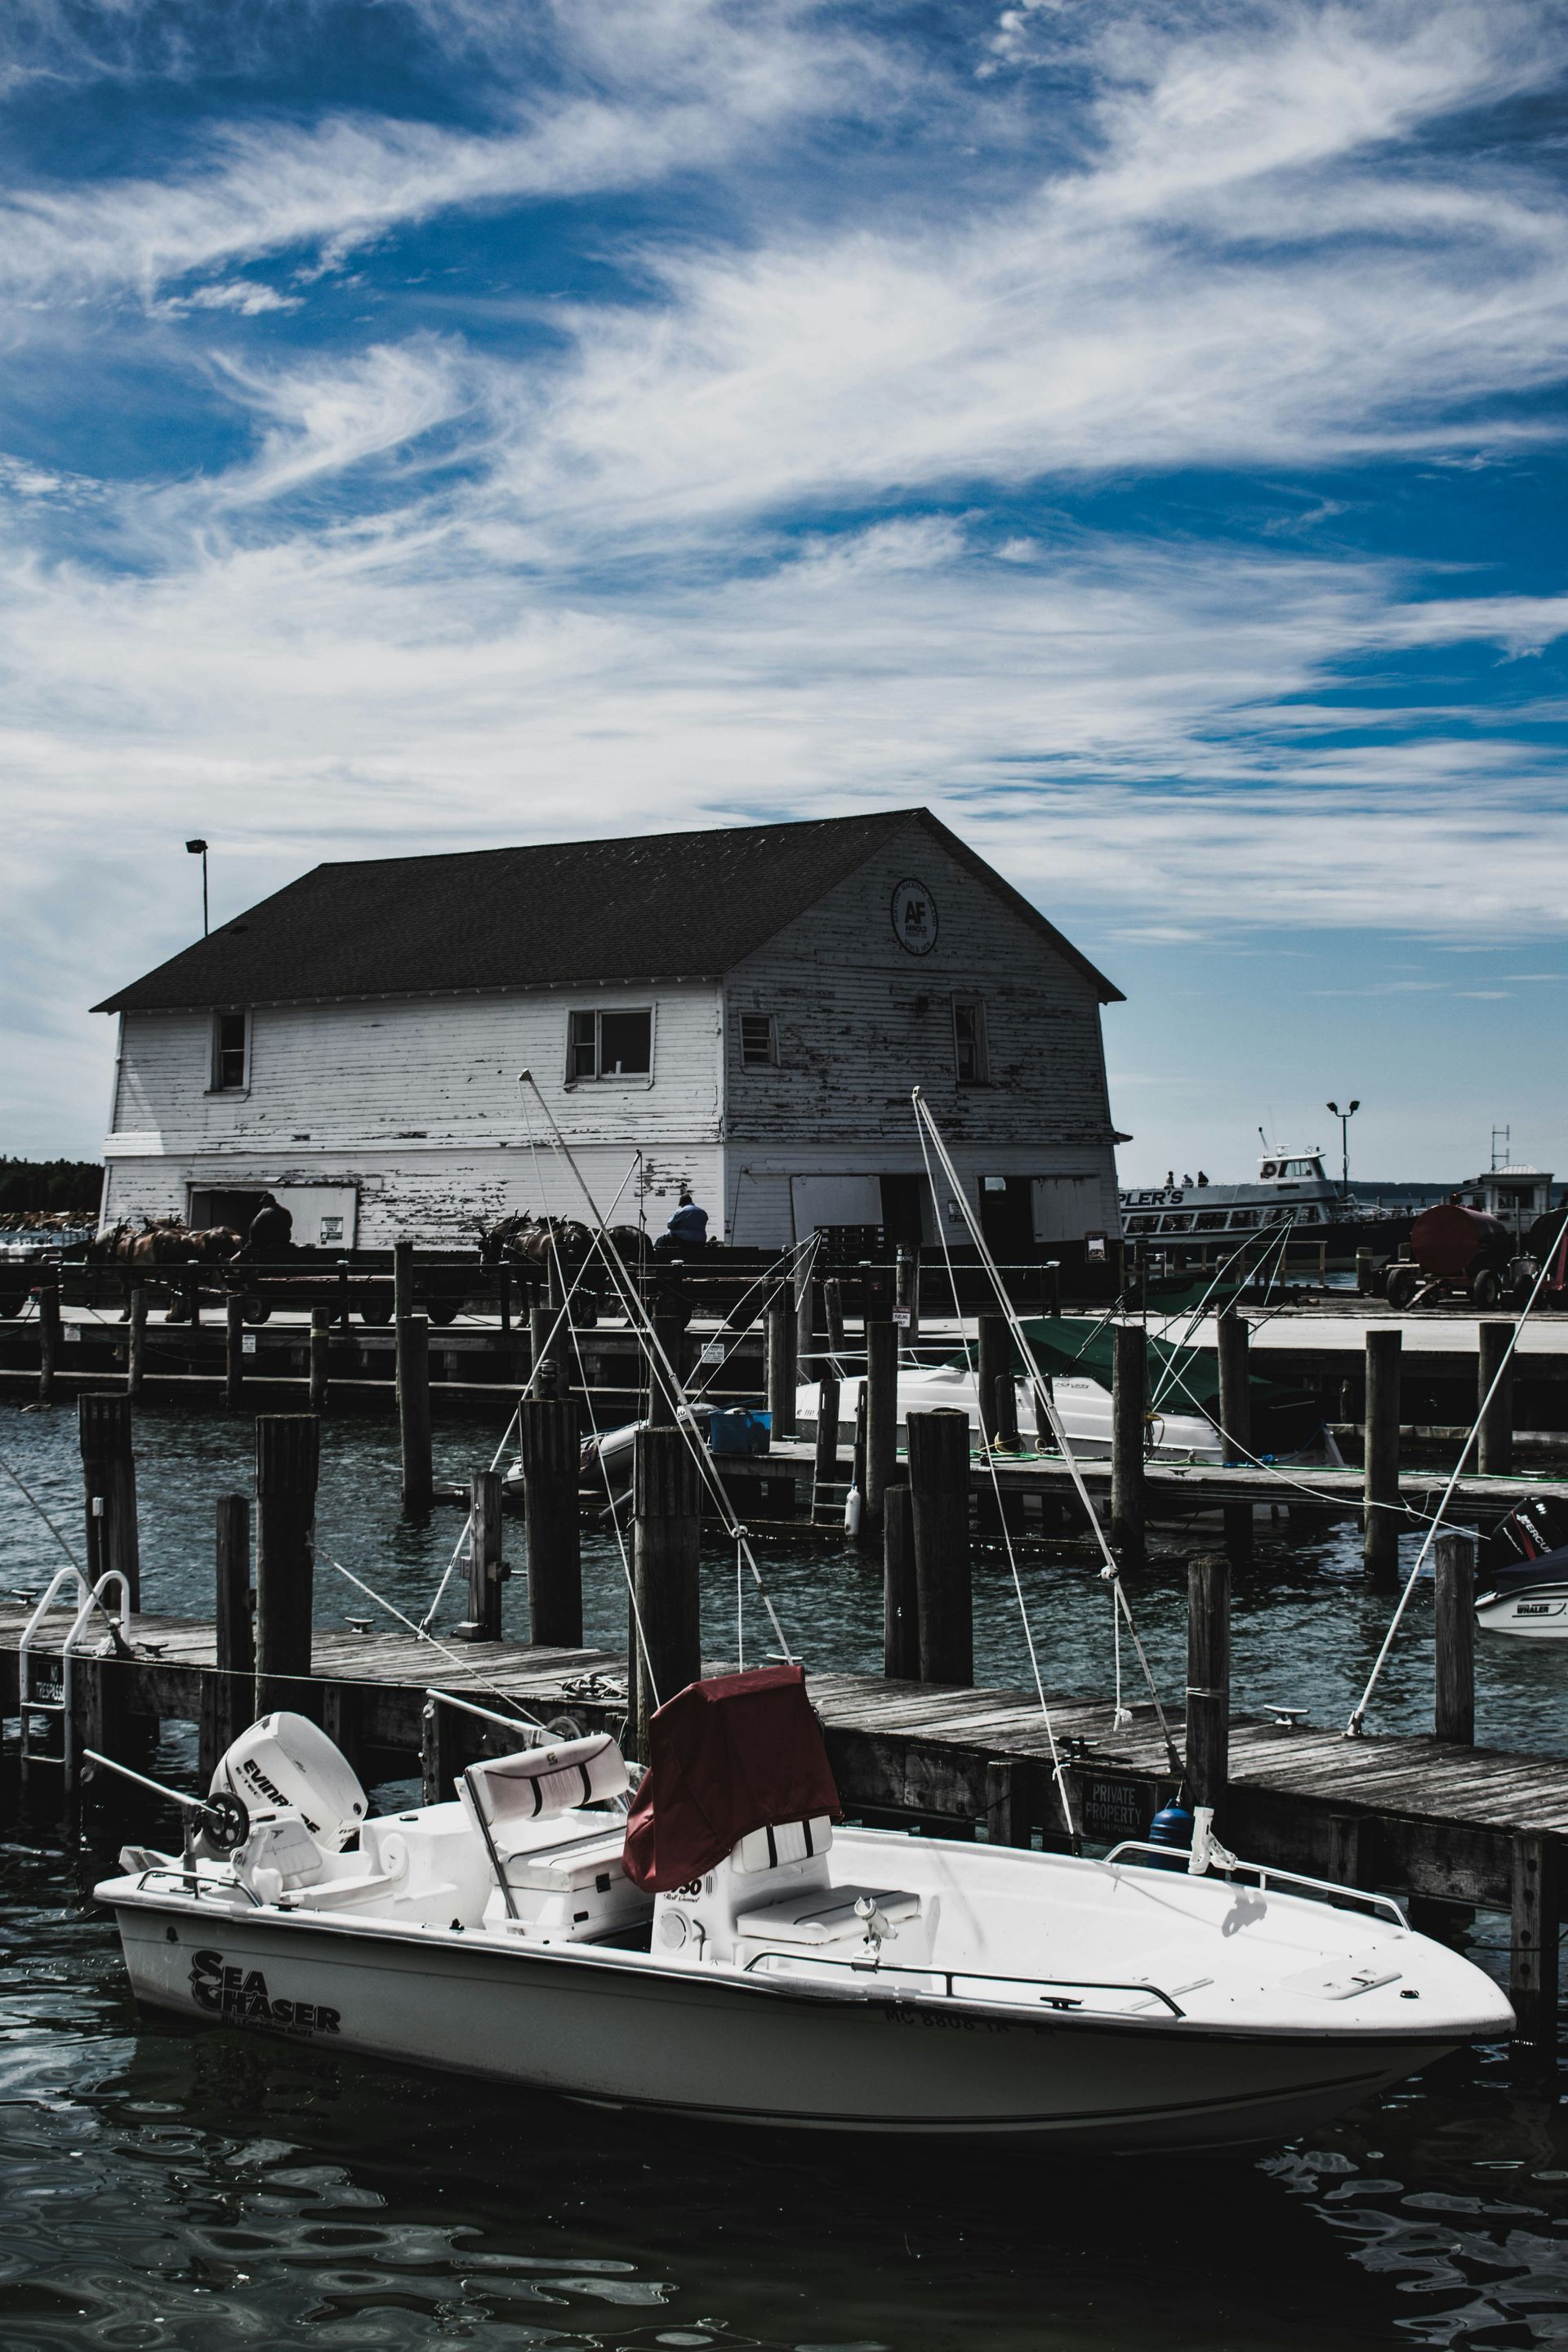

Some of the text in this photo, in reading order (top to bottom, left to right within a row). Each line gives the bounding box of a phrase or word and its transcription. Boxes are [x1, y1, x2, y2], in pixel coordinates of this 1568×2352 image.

[904, 900, 925, 924] AF
[905, 924, 927, 933] ARNOLD
[1517, 1606, 1549, 1614] WHALER
[1093, 1783, 1136, 1806] PRIVATE
[1085, 1802, 1143, 1825] PROPERTY
[189, 1949, 269, 1997] SEA
[191, 1979, 341, 2034] CHASER
[884, 2008, 915, 2025] MC
